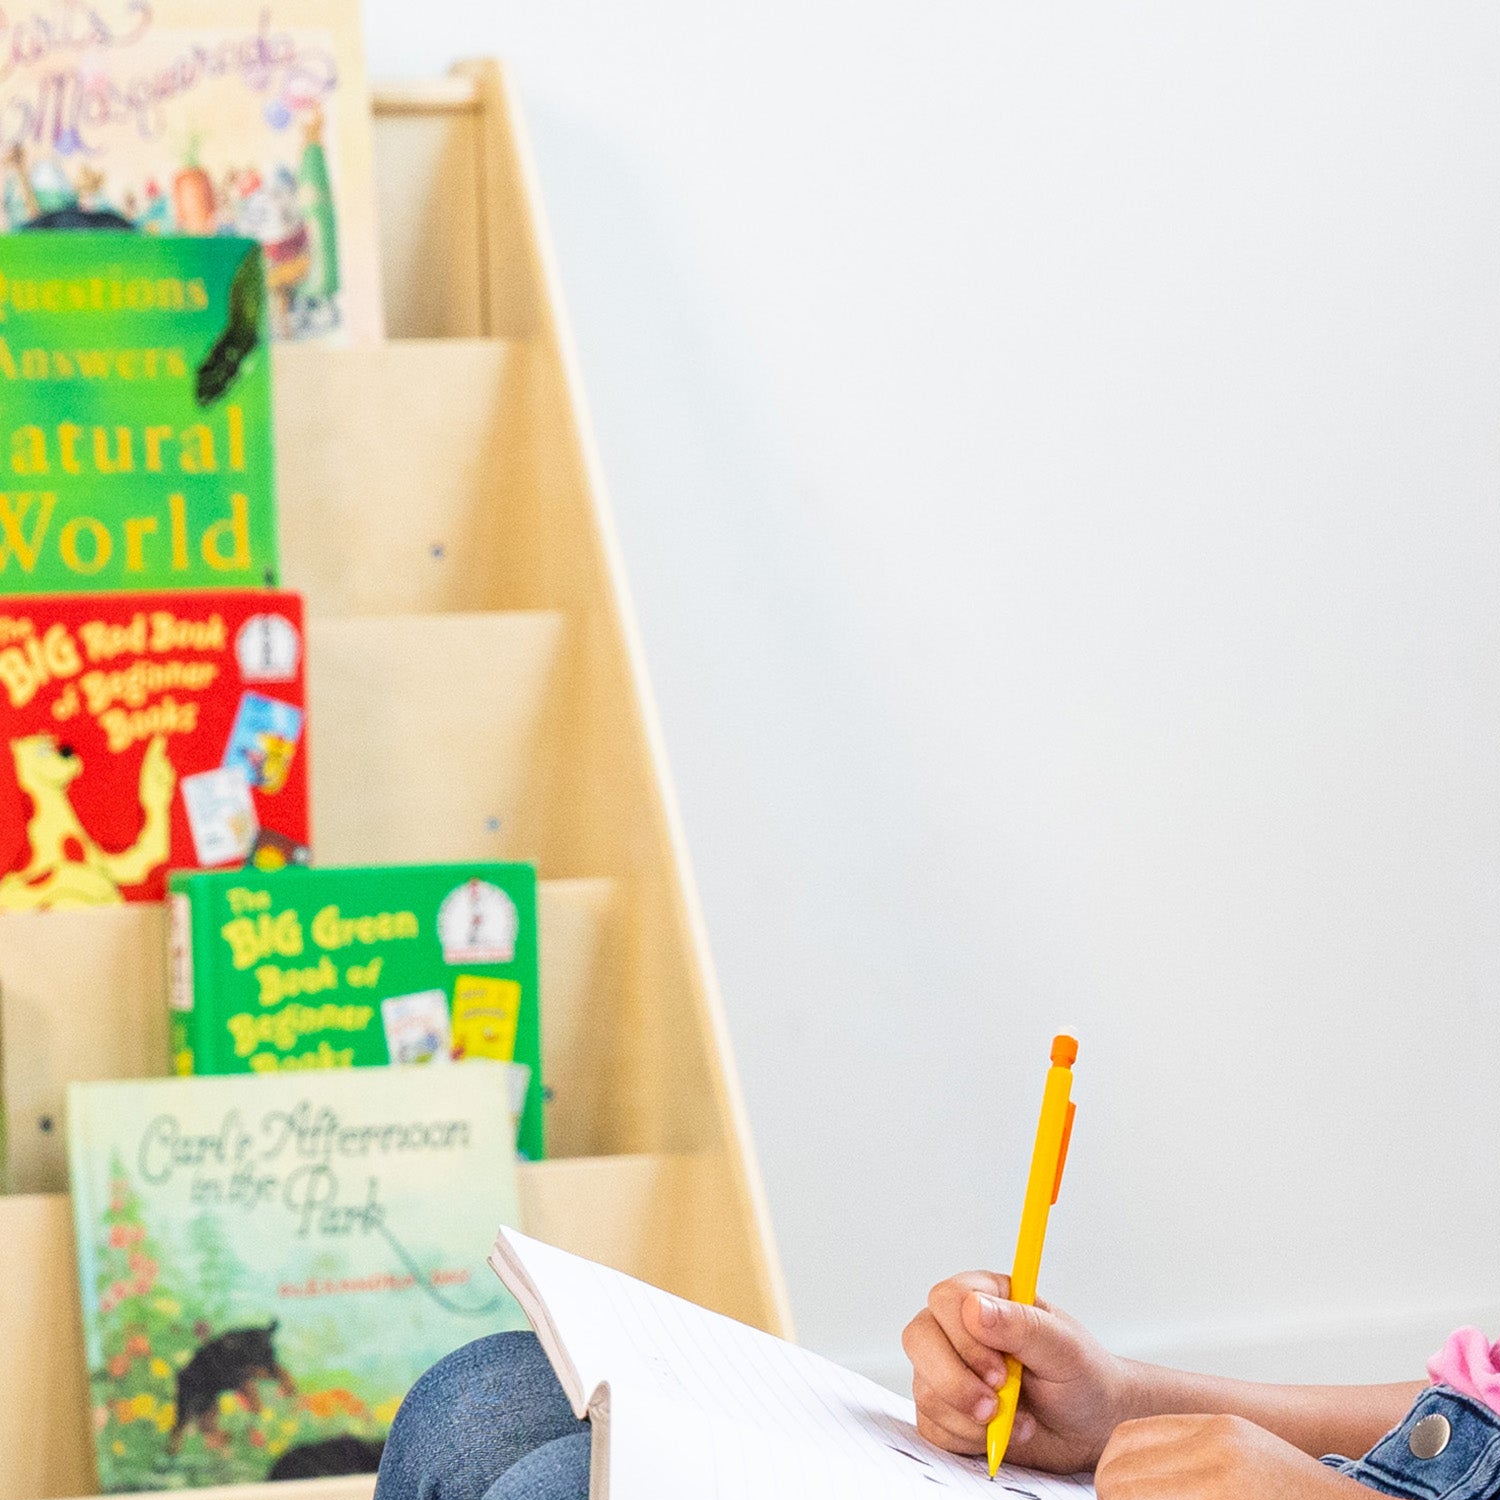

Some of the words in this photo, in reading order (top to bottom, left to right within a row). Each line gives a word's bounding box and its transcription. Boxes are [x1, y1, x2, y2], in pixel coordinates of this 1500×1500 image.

[0, 268, 208, 322] uestions
[10, 404, 245, 475] atural
[221, 909, 304, 970] BIG
[311, 905, 420, 950] Green
[255, 954, 339, 1007] Book
[345, 956, 384, 988] of
[227, 1003, 375, 1057] Beginner
[261, 1100, 472, 1166] Afternoon
[282, 1158, 389, 1241] Park
